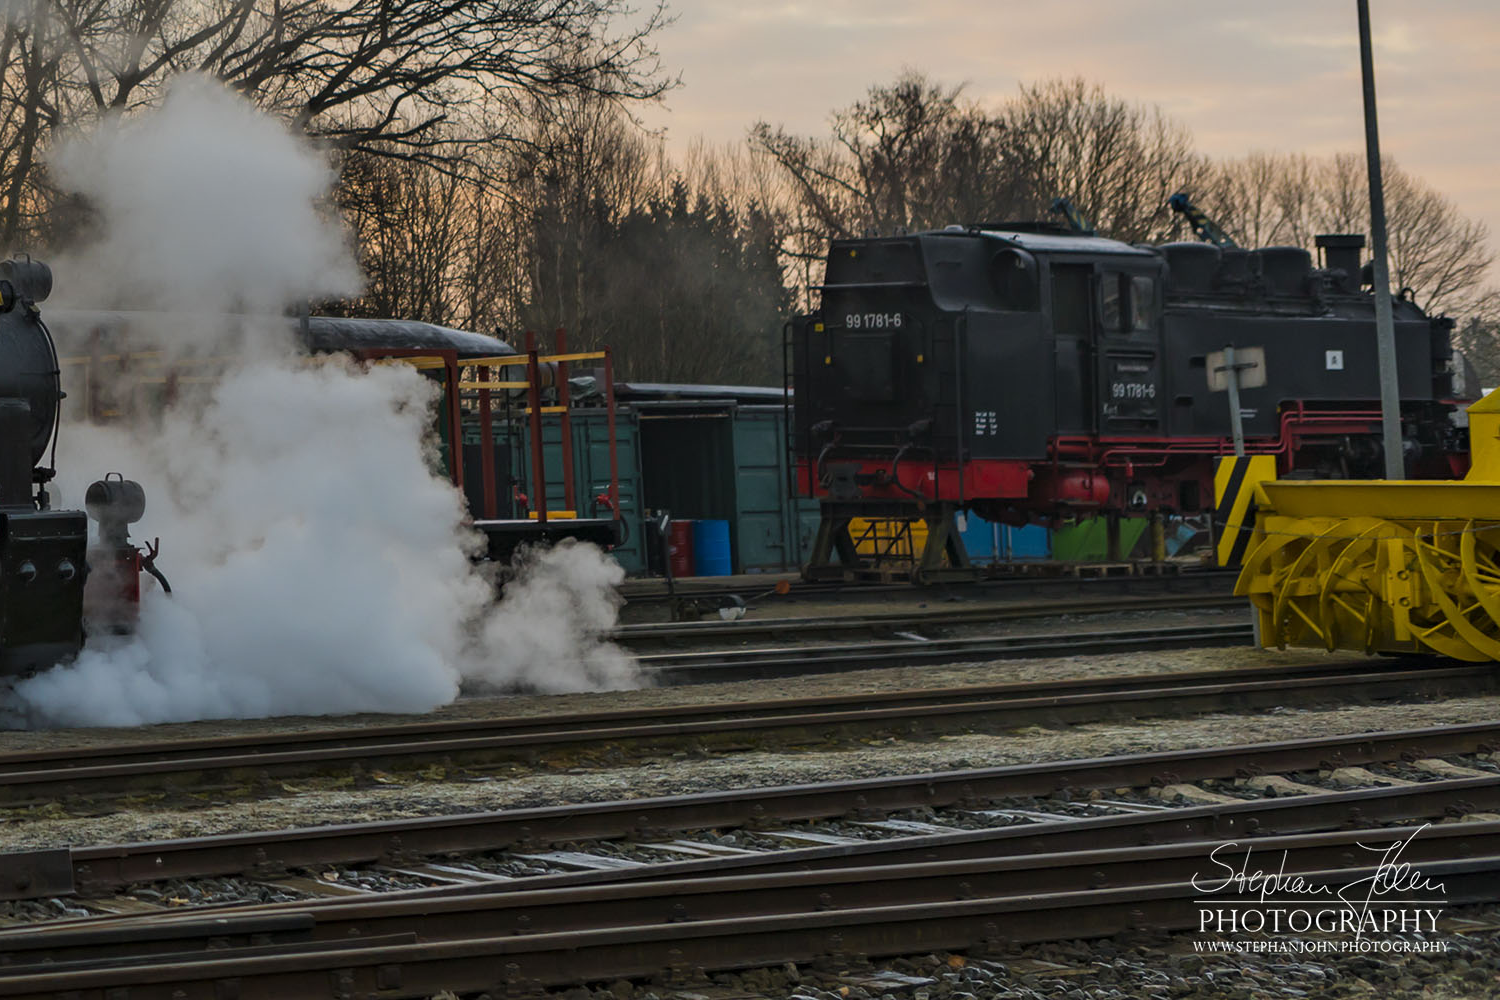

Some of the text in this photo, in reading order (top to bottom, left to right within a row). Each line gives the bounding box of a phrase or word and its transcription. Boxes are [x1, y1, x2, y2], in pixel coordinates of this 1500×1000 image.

[846, 313, 902, 328] 99 1781-6
[1126, 383, 1156, 398] 1781-6
